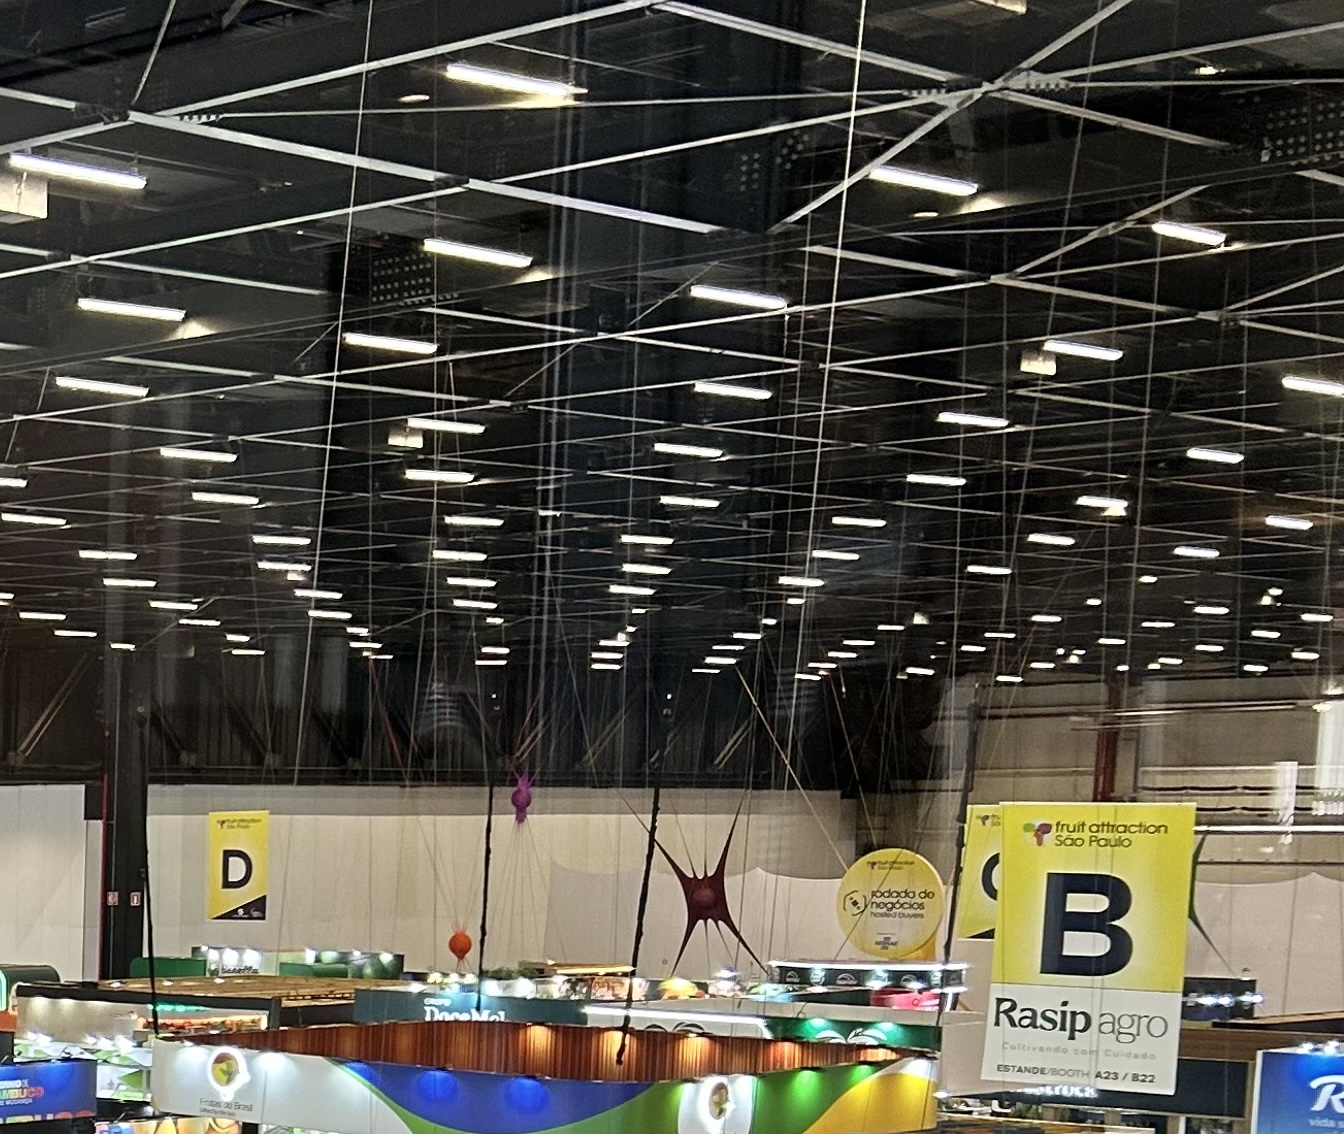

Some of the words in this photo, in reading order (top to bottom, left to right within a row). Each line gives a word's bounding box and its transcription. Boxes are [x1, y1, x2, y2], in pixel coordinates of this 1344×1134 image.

[1054, 835, 1085, 848] São
[1088, 836, 1133, 848] Paulo
[1056, 821, 1087, 834] fruit
[1088, 822, 1168, 835] attraction
[222, 850, 253, 889] D
[1040, 872, 1134, 976] B
[993, 997, 1093, 1041] Rasip
[1097, 1012, 1169, 1044] agro
